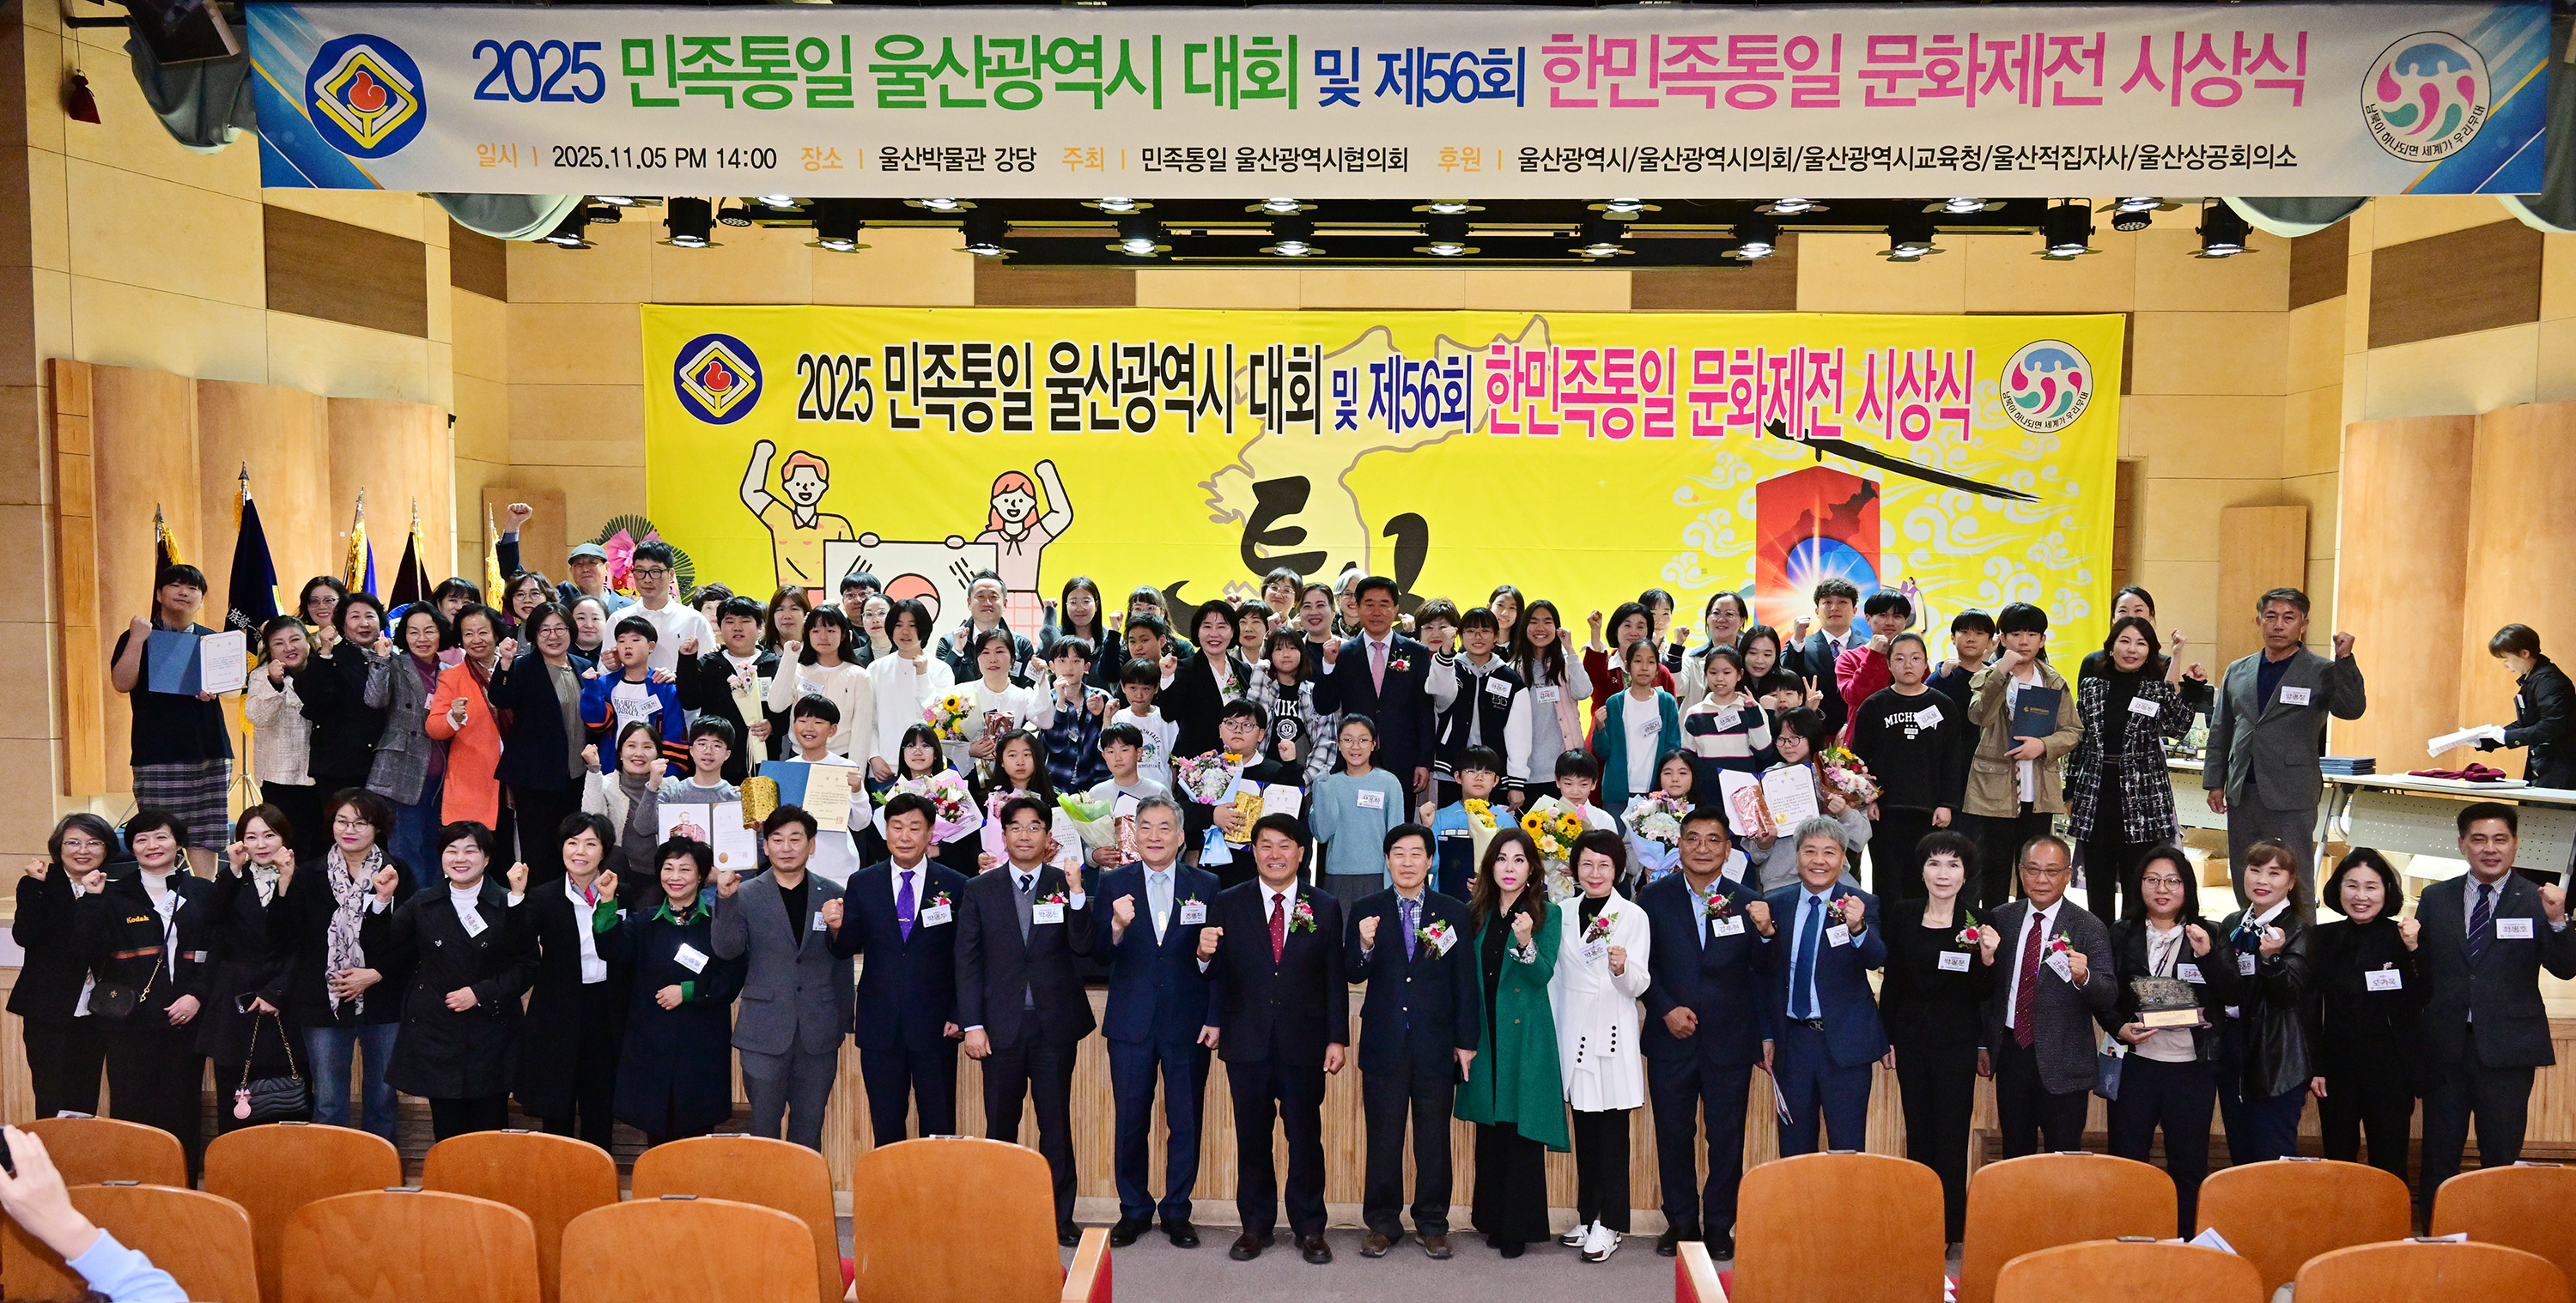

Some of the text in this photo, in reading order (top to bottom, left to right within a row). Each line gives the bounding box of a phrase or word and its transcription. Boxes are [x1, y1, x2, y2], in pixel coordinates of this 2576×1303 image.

[473, 31, 2308, 111] 2025 민족통일 울산광역시 대회 및 제56회 한민족통일 문화제전 시상식
[2365, 103, 2486, 157] 남북이 하나되면 세계가 우리무대
[475, 143, 517, 168] 일시
[552, 146, 777, 170] 2025.11.05 PM 14:00
[800, 146, 844, 172] 장소
[878, 146, 1036, 173] 울산박물관 강당
[1061, 147, 1105, 173] 주최
[1141, 146, 1409, 173] 민족통일 울산광역시협의회
[1437, 147, 1482, 173] 후원
[797, 342, 1974, 441] 2025 민족통일 울산광역시 대회 및 제56회 한민족통일 문화제전 시상식
[126, 915, 149, 924] Kodak
